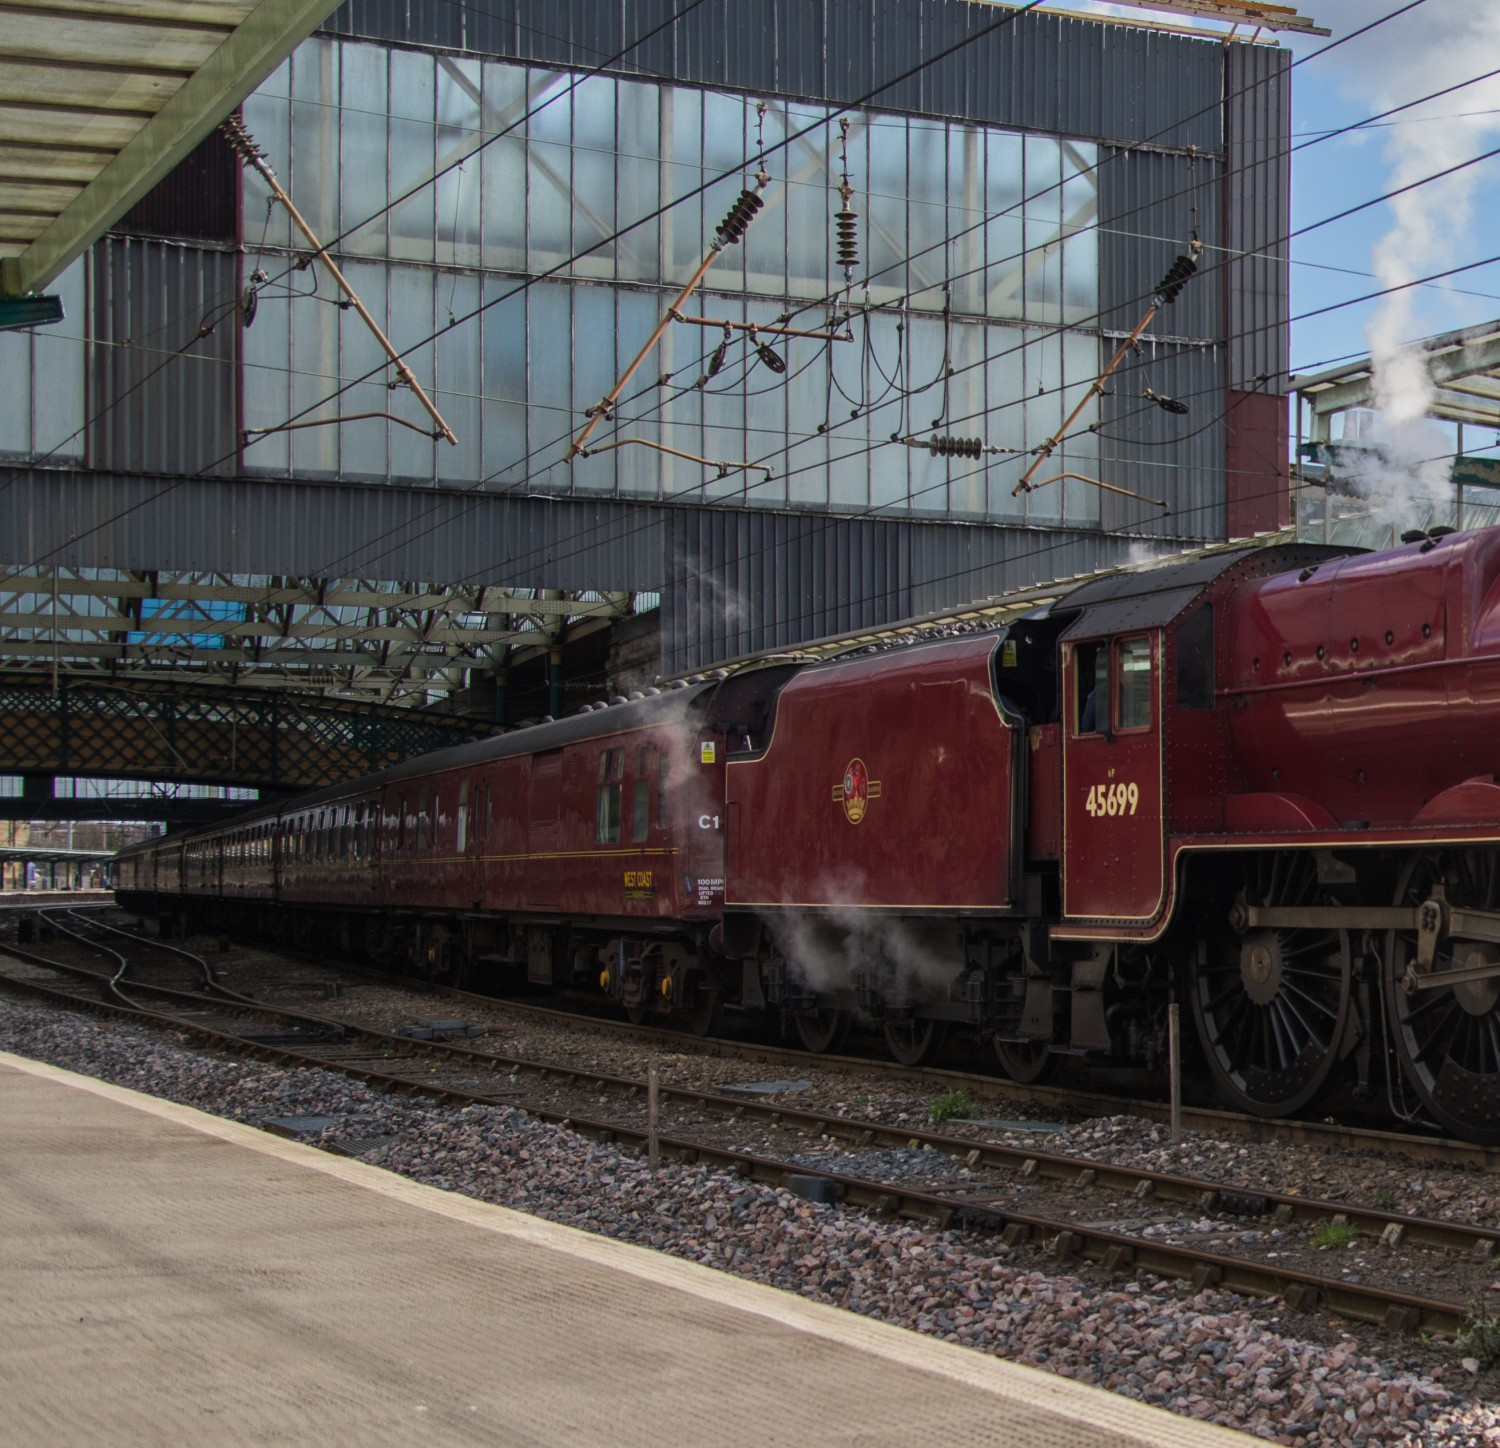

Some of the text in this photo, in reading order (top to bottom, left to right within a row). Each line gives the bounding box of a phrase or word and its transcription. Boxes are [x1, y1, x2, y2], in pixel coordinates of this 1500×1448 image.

[1085, 782, 1139, 817] 45699
[698, 814, 719, 829] C1
[624, 871, 652, 887] WEST COAST
